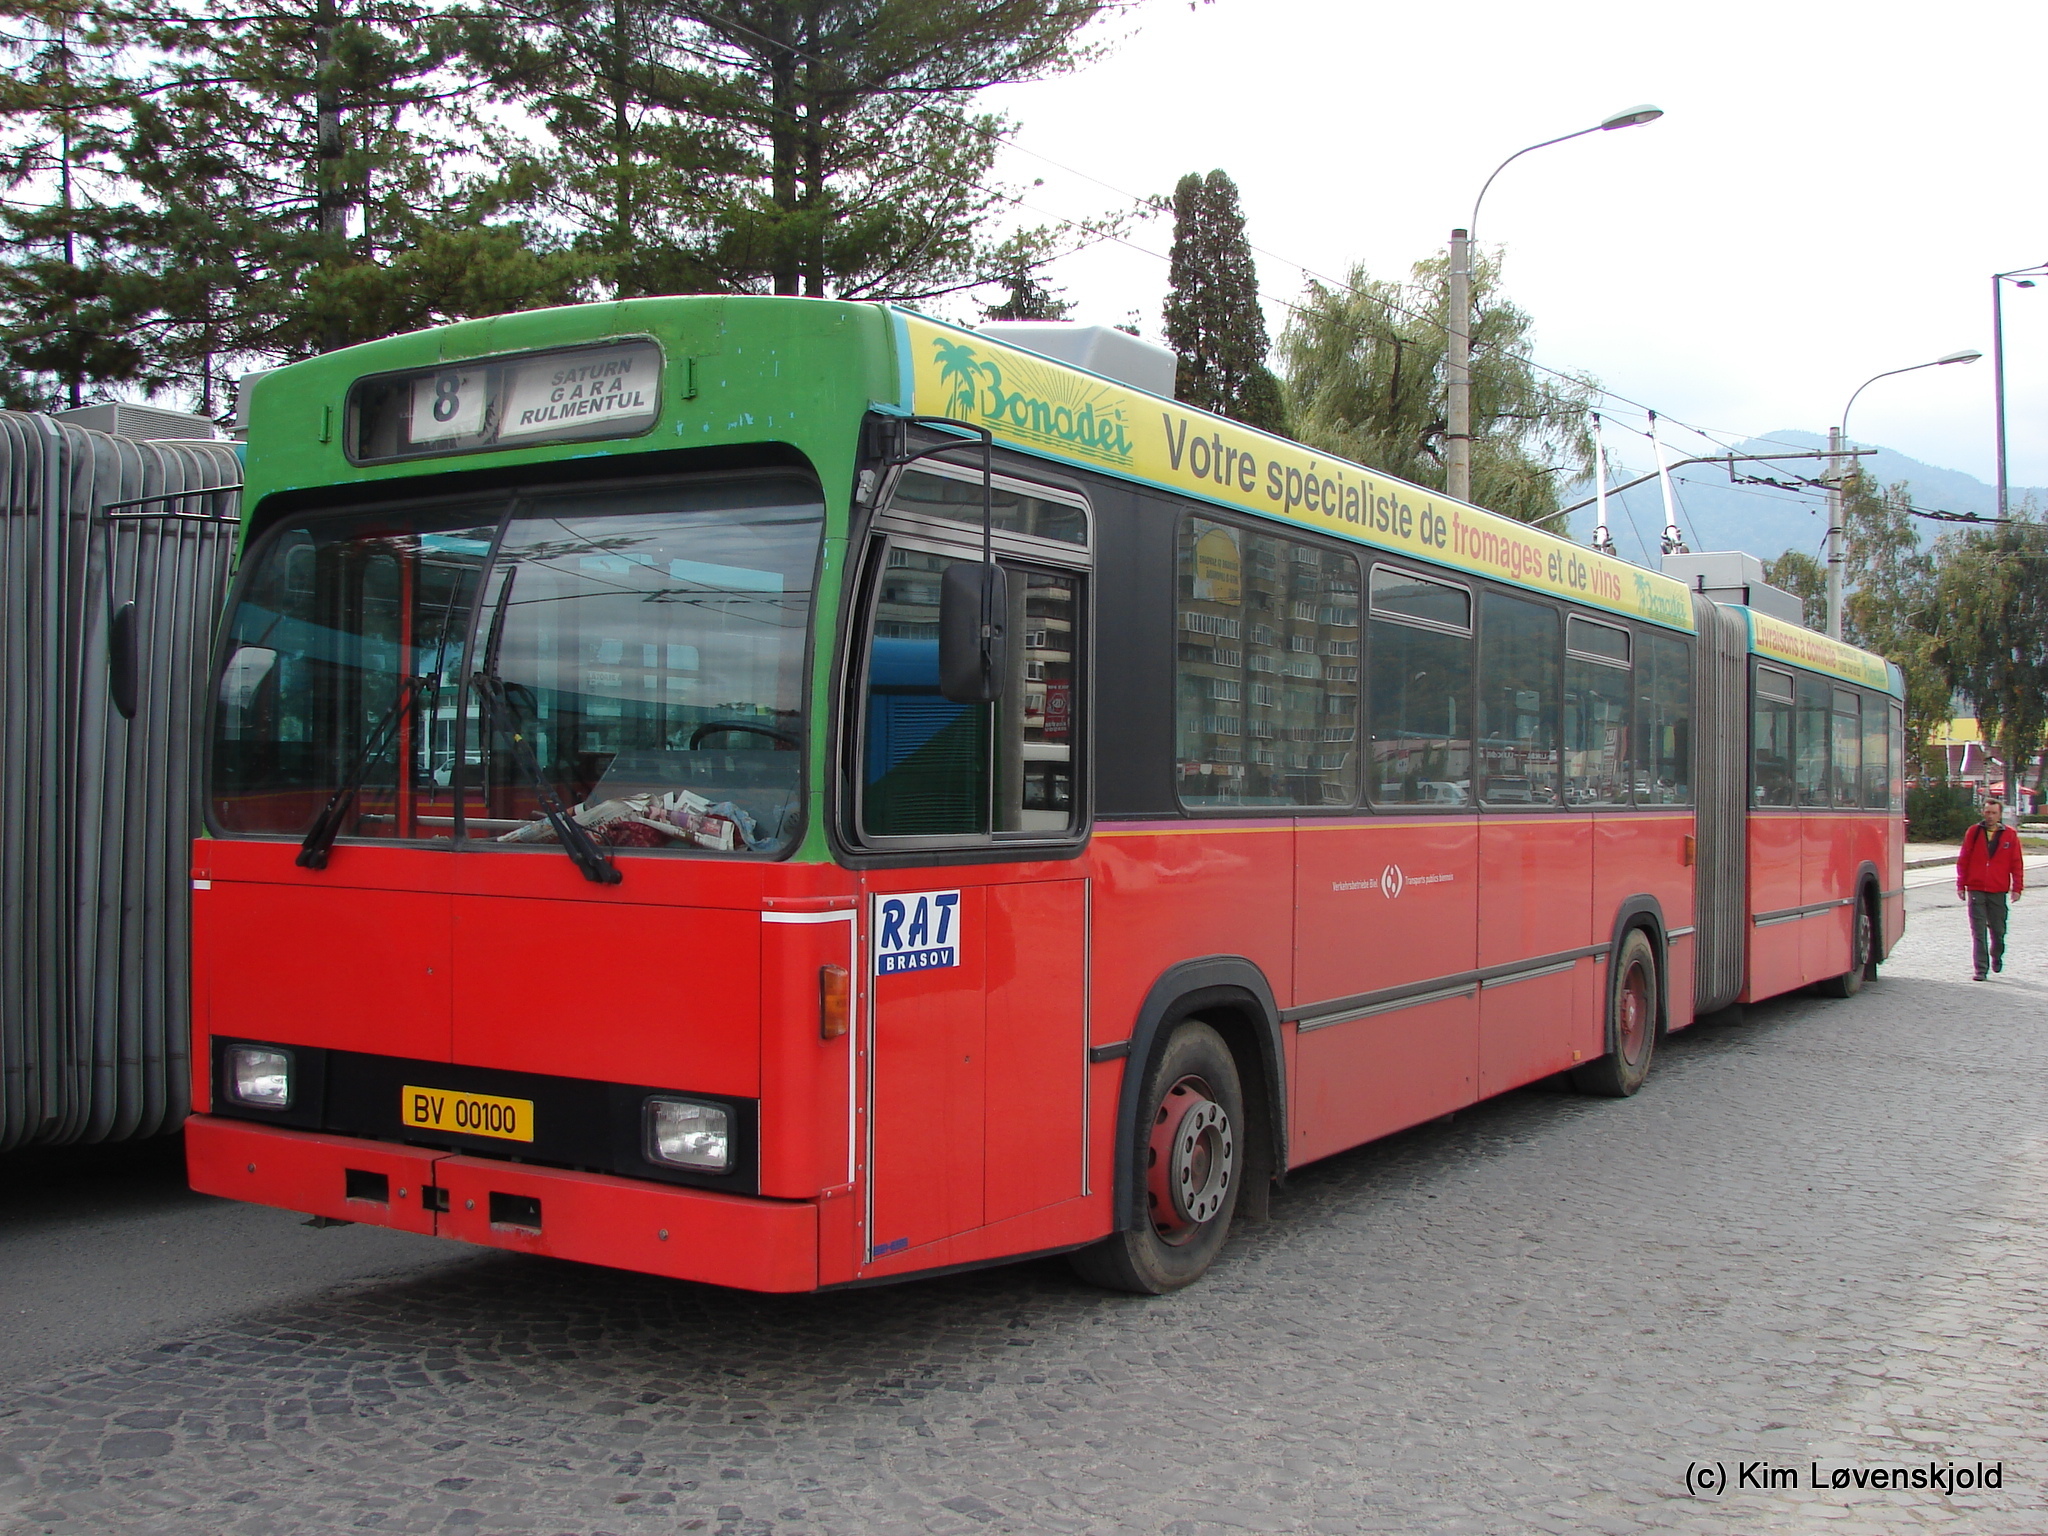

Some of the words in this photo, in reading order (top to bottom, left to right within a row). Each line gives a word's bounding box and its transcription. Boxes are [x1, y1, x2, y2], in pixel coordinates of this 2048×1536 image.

[550, 379, 622, 403] GARA
[551, 357, 634, 386] SATURN
[433, 371, 460, 423] 8
[519, 390, 645, 426] RULMENTUL
[980, 361, 1134, 456] Bonadei
[1162, 412, 1257, 493] Votre
[1266, 460, 1412, 539] spécialiste
[1419, 502, 1446, 549] de
[1452, 511, 1543, 580] fromages
[1548, 551, 1564, 585] et
[1568, 552, 1587, 589] de
[1591, 562, 1622, 601] vins
[1755, 618, 1799, 657] Livraisons
[1405, 875, 1426, 886] Transports
[881, 893, 959, 951] RAT
[886, 950, 949, 971] BRASOV
[414, 1094, 445, 1124] BV
[456, 1099, 516, 1133] 00100
